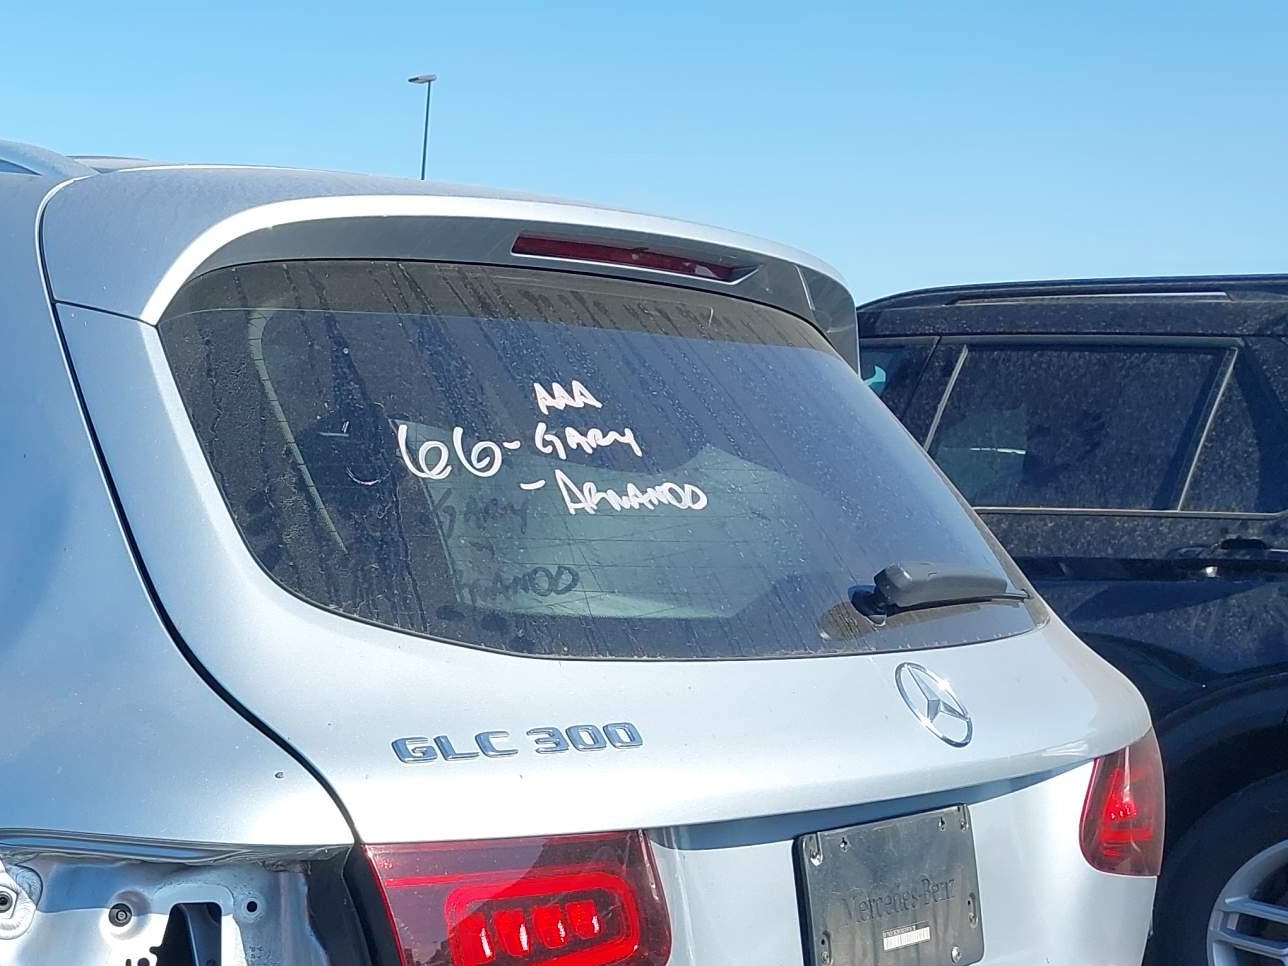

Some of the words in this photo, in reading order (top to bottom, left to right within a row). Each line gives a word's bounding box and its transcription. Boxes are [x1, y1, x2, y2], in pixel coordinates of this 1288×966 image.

[533, 379, 603, 415] AAA
[391, 730, 520, 765] GLC
[526, 721, 645, 755] 300
